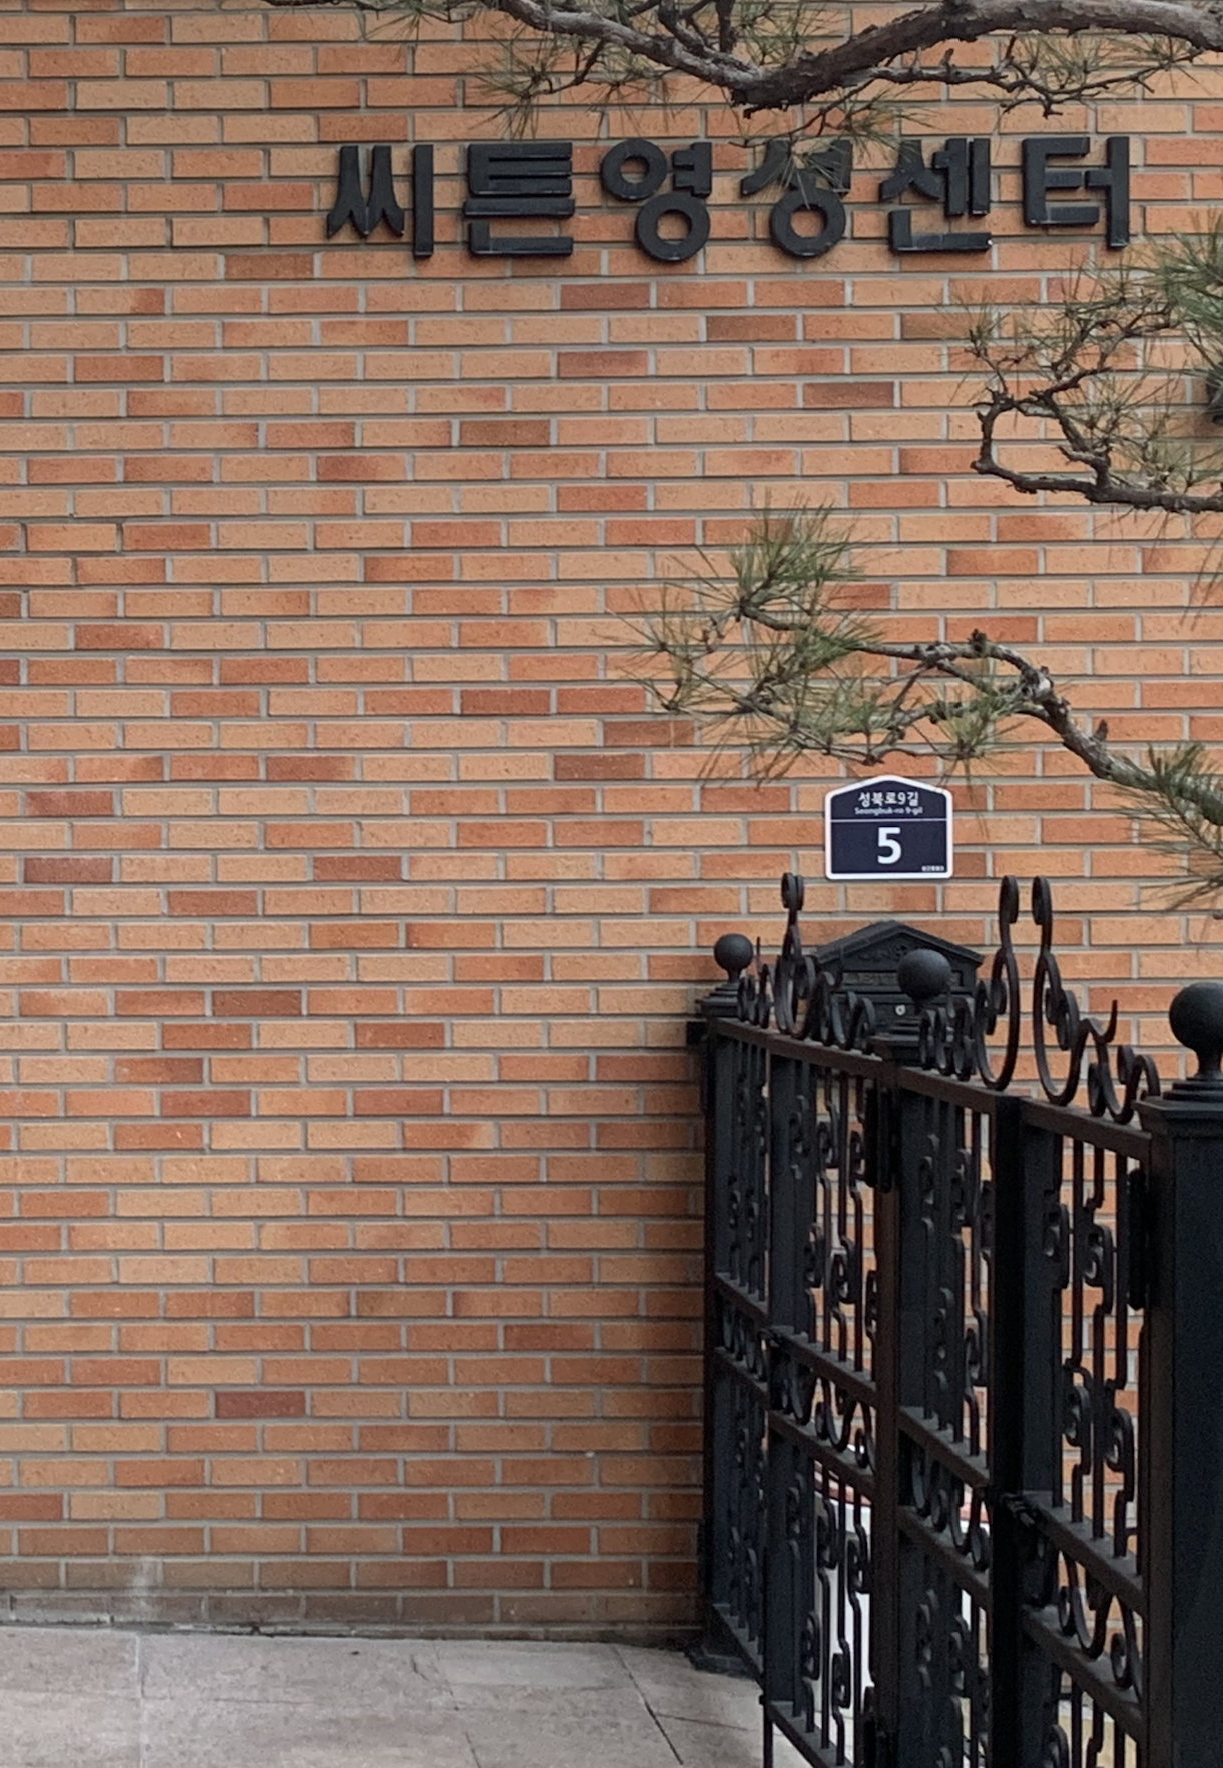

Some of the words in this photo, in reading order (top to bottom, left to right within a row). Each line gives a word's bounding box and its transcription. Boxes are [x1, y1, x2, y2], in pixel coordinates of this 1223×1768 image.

[326, 137, 1131, 264] 씨튼영성센터
[854, 805, 904, 817] Seongbuk-ro
[858, 791, 919, 808] 성북로9길
[877, 826, 902, 864] 5
